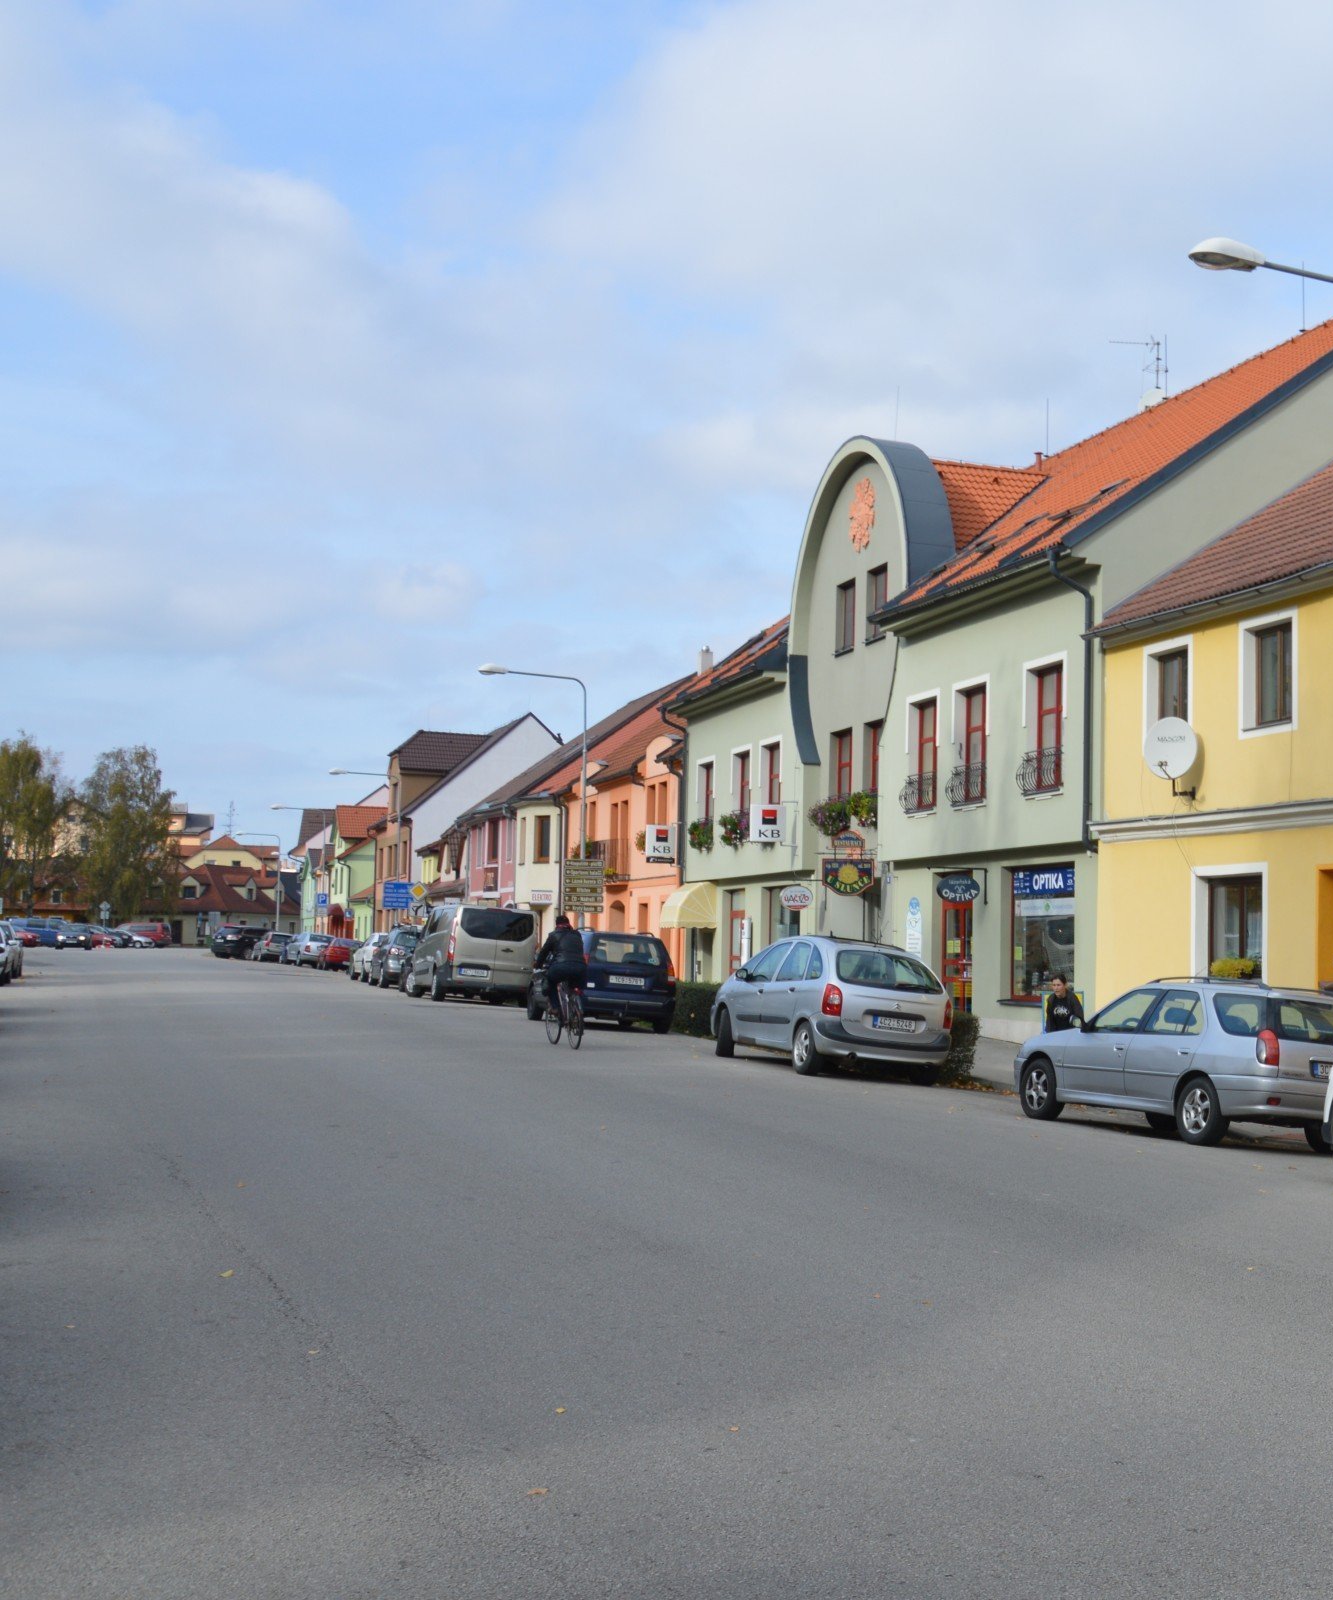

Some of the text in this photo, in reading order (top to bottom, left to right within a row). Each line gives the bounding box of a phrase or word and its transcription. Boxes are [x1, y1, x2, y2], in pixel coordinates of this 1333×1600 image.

[758, 829, 780, 838] KB
[653, 845, 671, 854] KB
[835, 875, 871, 892] SLUNCE
[1033, 873, 1064, 890] OPTIKA
[942, 889, 978, 901] OPTIKA
[1320, 1064, 1332, 1075] 3C
